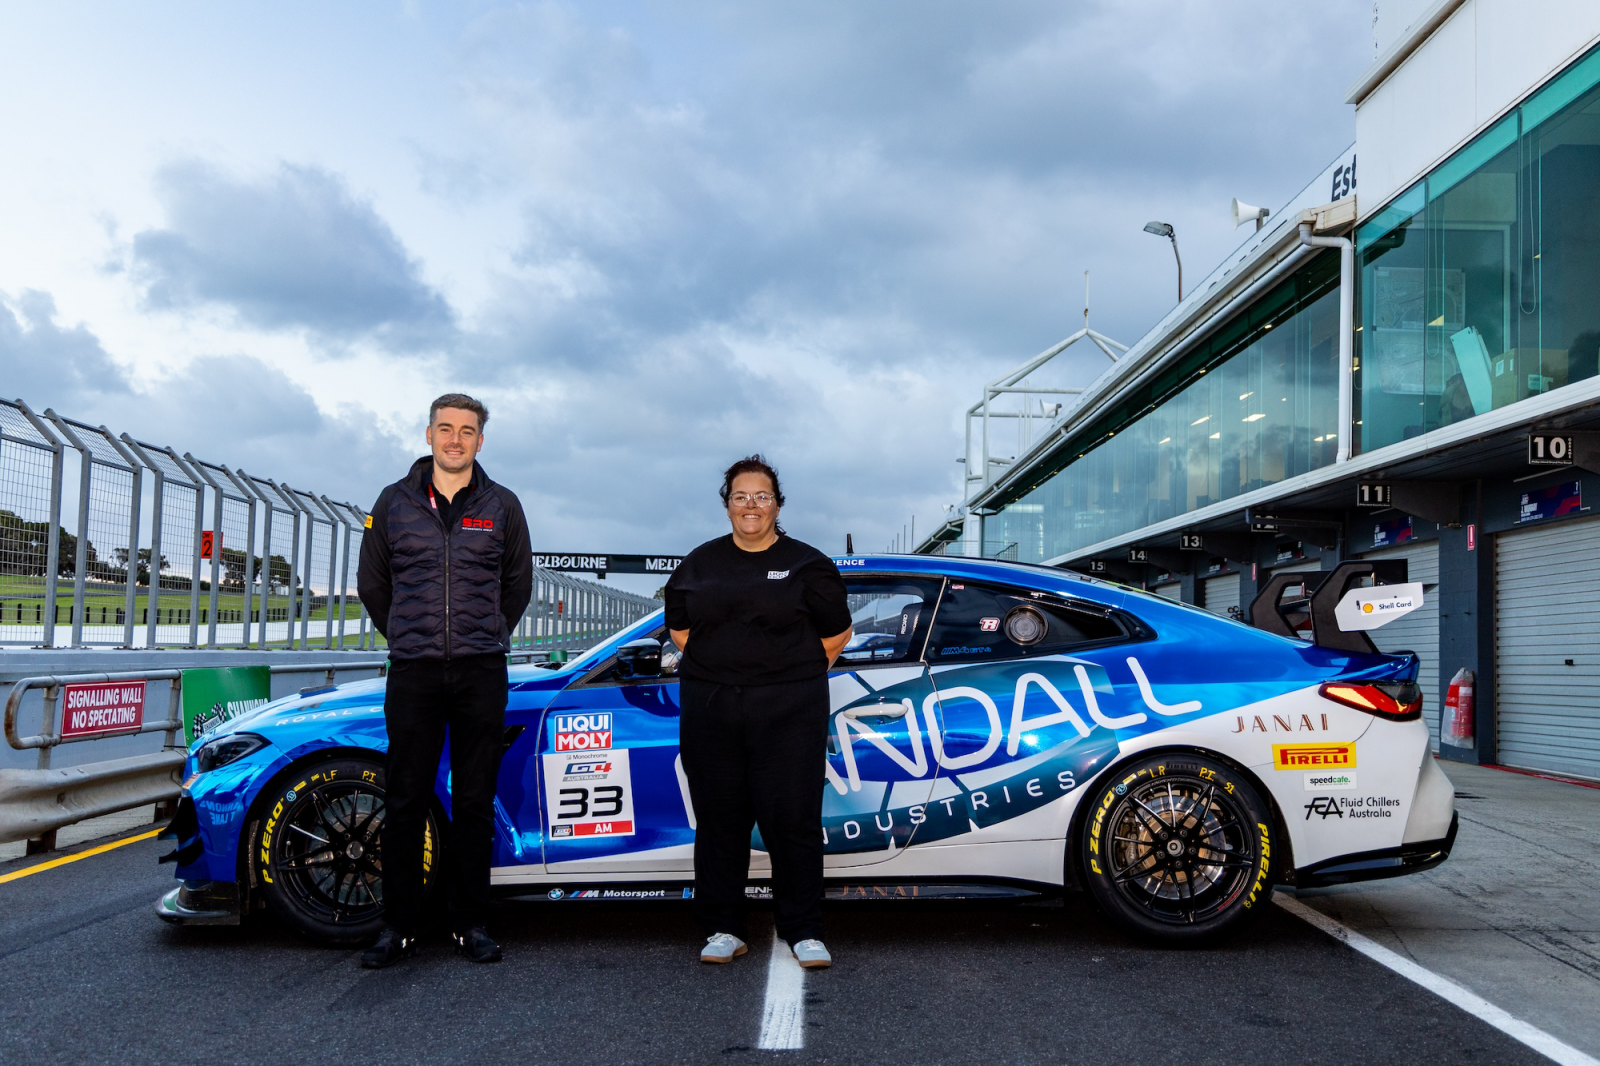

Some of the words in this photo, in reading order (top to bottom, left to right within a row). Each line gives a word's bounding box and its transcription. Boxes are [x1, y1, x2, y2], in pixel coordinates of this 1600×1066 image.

[1533, 437, 1566, 458] 10
[1361, 485, 1383, 502] 11
[462, 518, 493, 528] SRO
[203, 540, 212, 556] 2
[1183, 536, 1200, 547] 13
[1131, 551, 1146, 560] 14
[1091, 562, 1104, 571] 15
[1379, 602, 1395, 610] Shell
[68, 690, 120, 708] SIGNALLING
[121, 687, 142, 703] WALL
[71, 712, 87, 728] NO
[88, 707, 136, 725] SPECTATING
[275, 710, 353, 727] ROYAL
[558, 715, 609, 732] LIQUI
[1231, 713, 1328, 733] JANAI
[558, 732, 610, 750] MOLY
[1280, 748, 1349, 765] PIRELLI
[323, 770, 337, 782] LF
[557, 786, 623, 819] 33
[1340, 797, 1363, 807] Fluid
[1366, 797, 1400, 807] Chillers
[1349, 808, 1391, 818] Australia
[595, 823, 612, 833] AM
[1089, 790, 1115, 854] ZERO
[261, 800, 284, 866] ZERO
[1091, 861, 1102, 874] P
[1257, 822, 1271, 903] PIRELLI
[262, 869, 273, 884] P
[603, 889, 665, 898] Motorsport
[837, 886, 918, 896] JANAI
